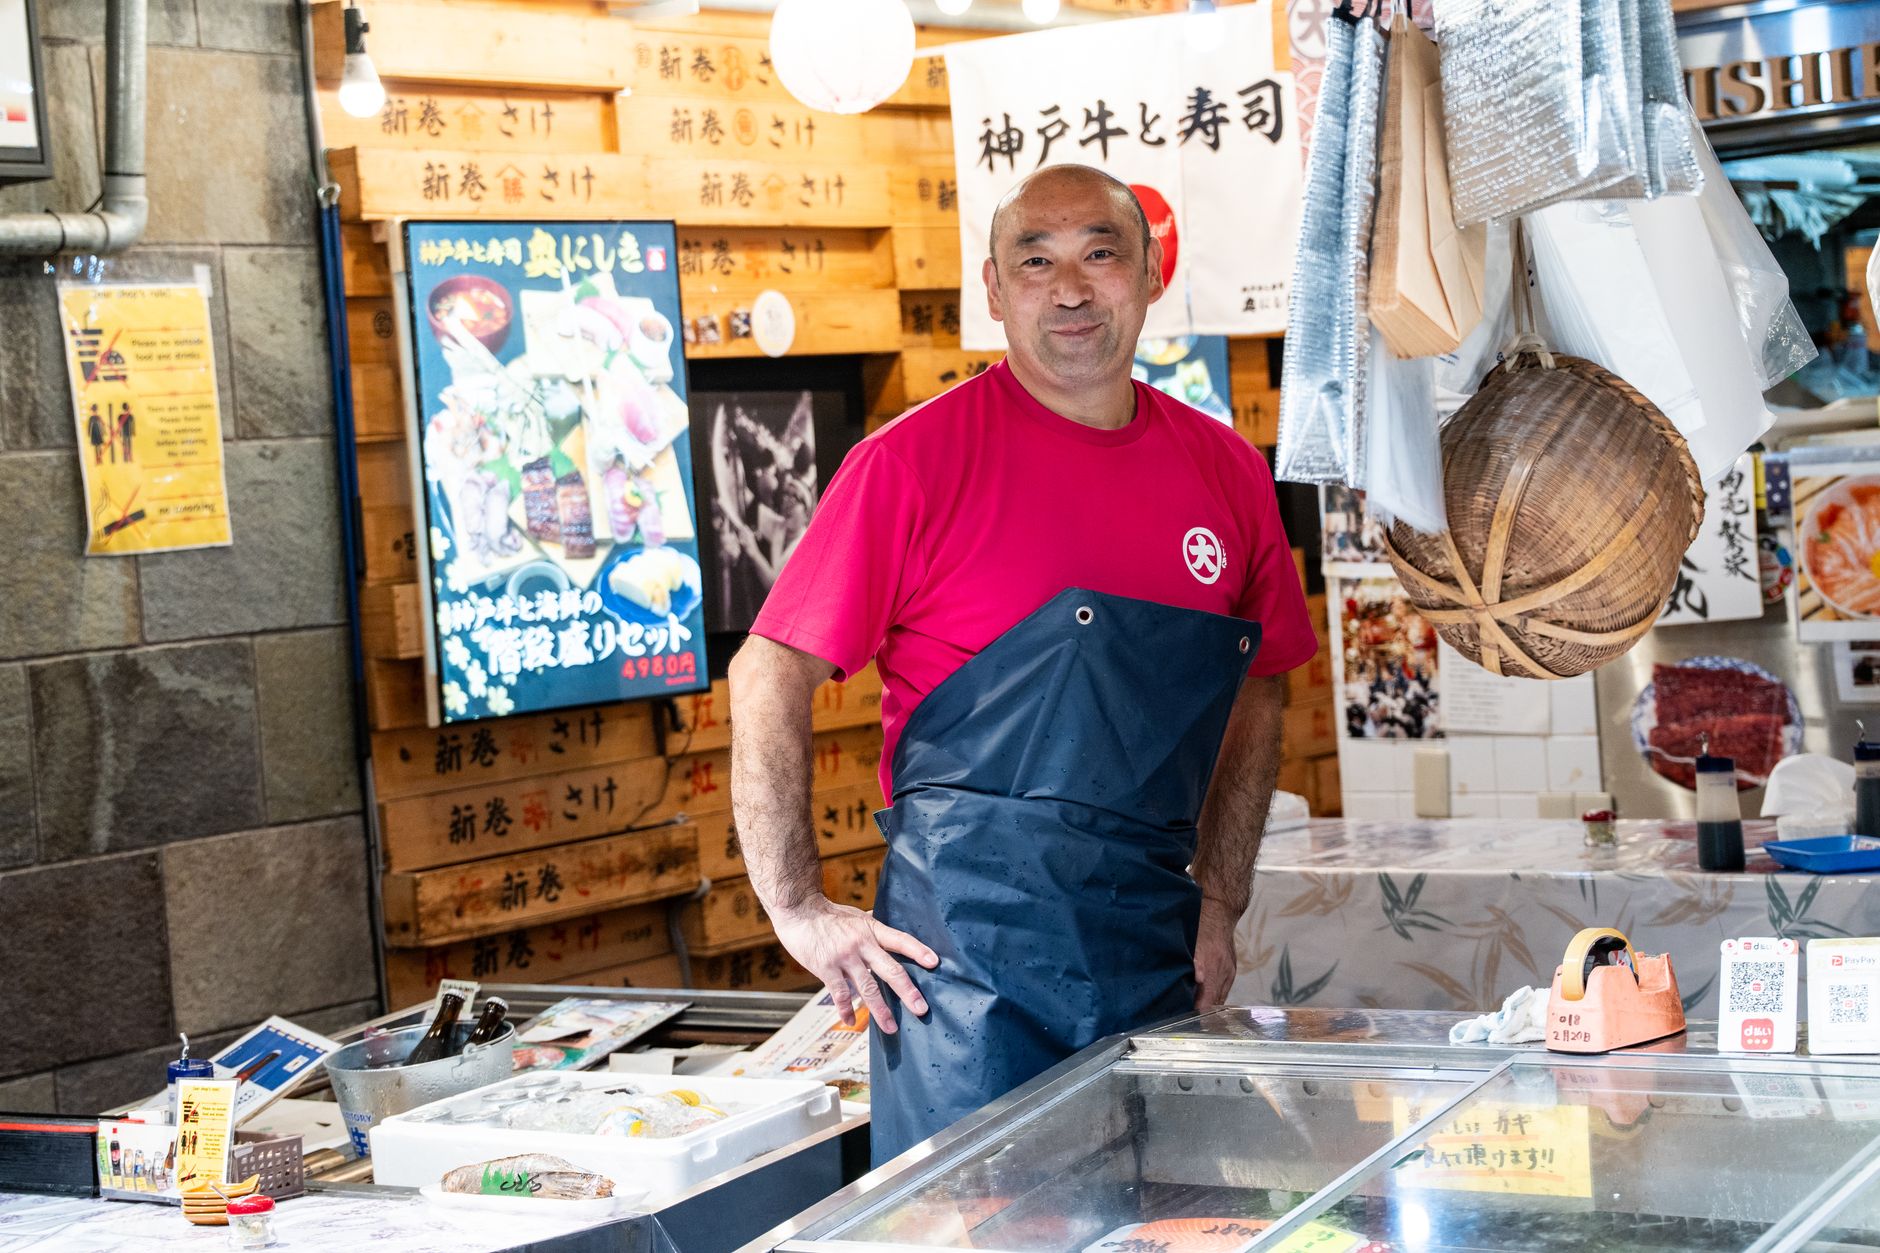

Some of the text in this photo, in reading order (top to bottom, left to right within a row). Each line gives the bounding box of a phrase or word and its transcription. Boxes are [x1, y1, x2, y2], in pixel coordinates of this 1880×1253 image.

[977, 78, 1283, 172] 神戸牛と寿司
[421, 161, 487, 202] 新巻
[540, 165, 596, 202] さけ
[524, 227, 645, 279] 奥にしき
[1188, 534, 1217, 573] 大
[622, 652, 696, 680] 4980円
[435, 729, 500, 775] 新巻
[549, 710, 606, 755] さけ
[449, 797, 514, 845] 新巻
[563, 777, 619, 821] さけ
[501, 864, 564, 911] 新巻
[1845, 956, 1876, 966] PayPay
